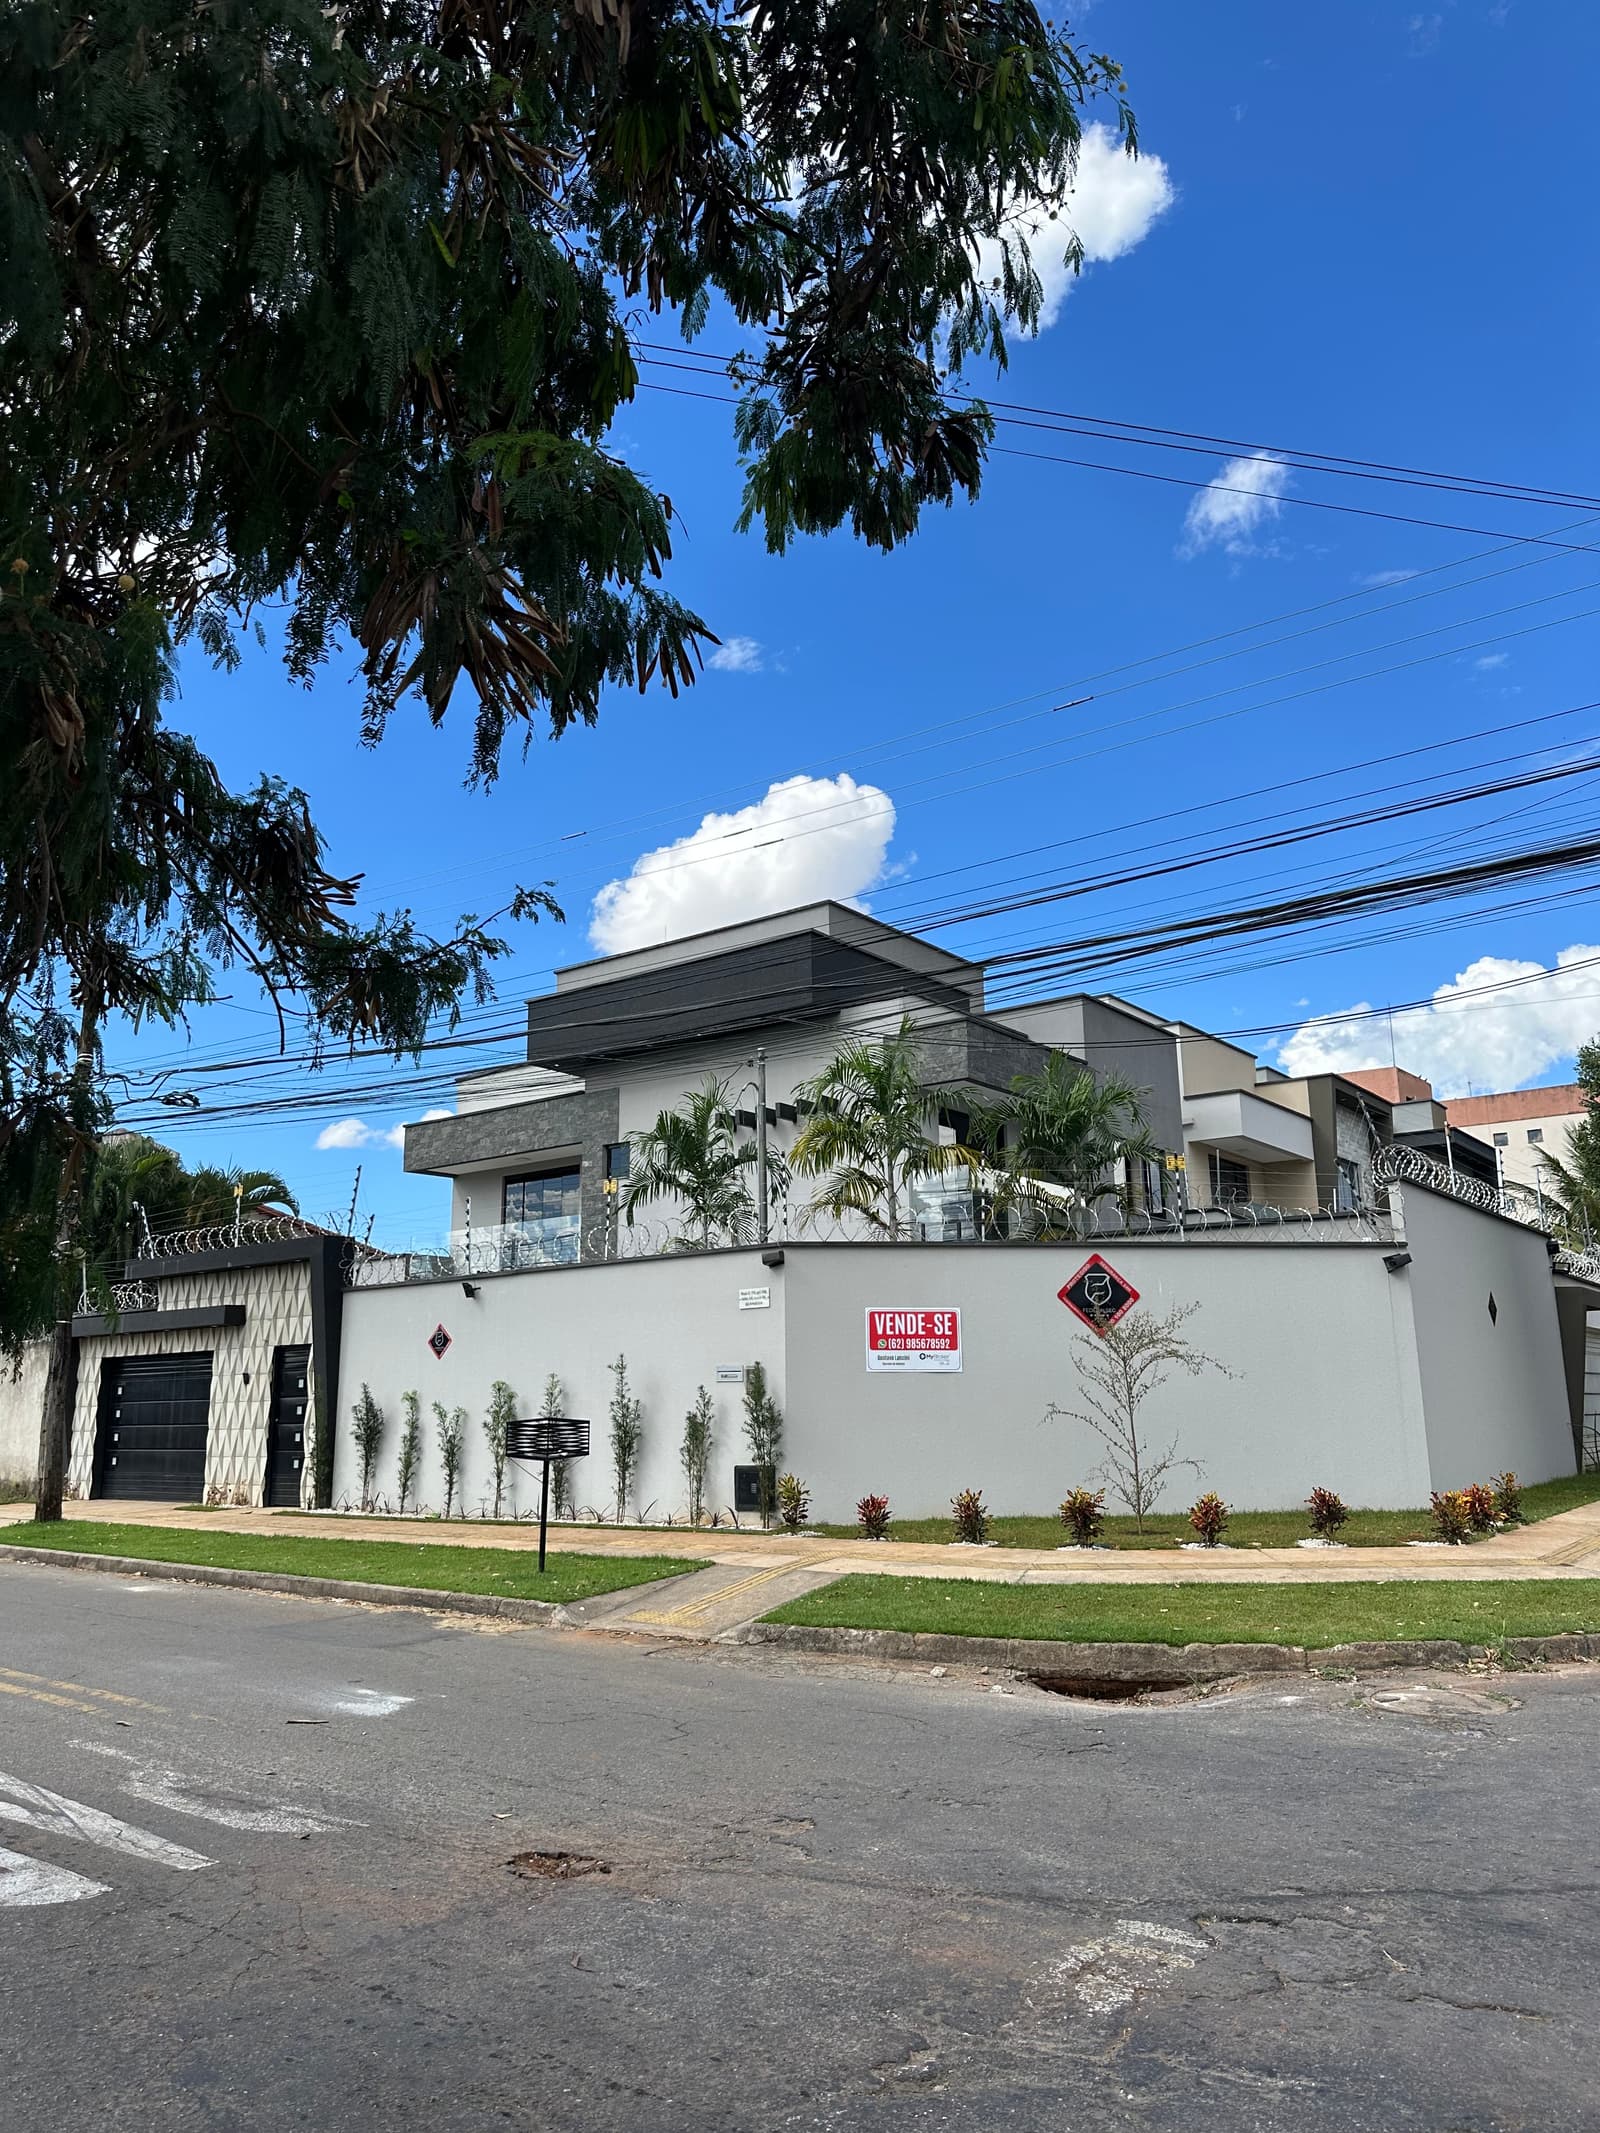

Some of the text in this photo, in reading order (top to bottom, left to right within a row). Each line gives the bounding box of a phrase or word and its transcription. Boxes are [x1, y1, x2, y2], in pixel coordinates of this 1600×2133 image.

[875, 1314, 952, 1335] VENDE-SE
[888, 1338, 950, 1349] (62) 985678592
